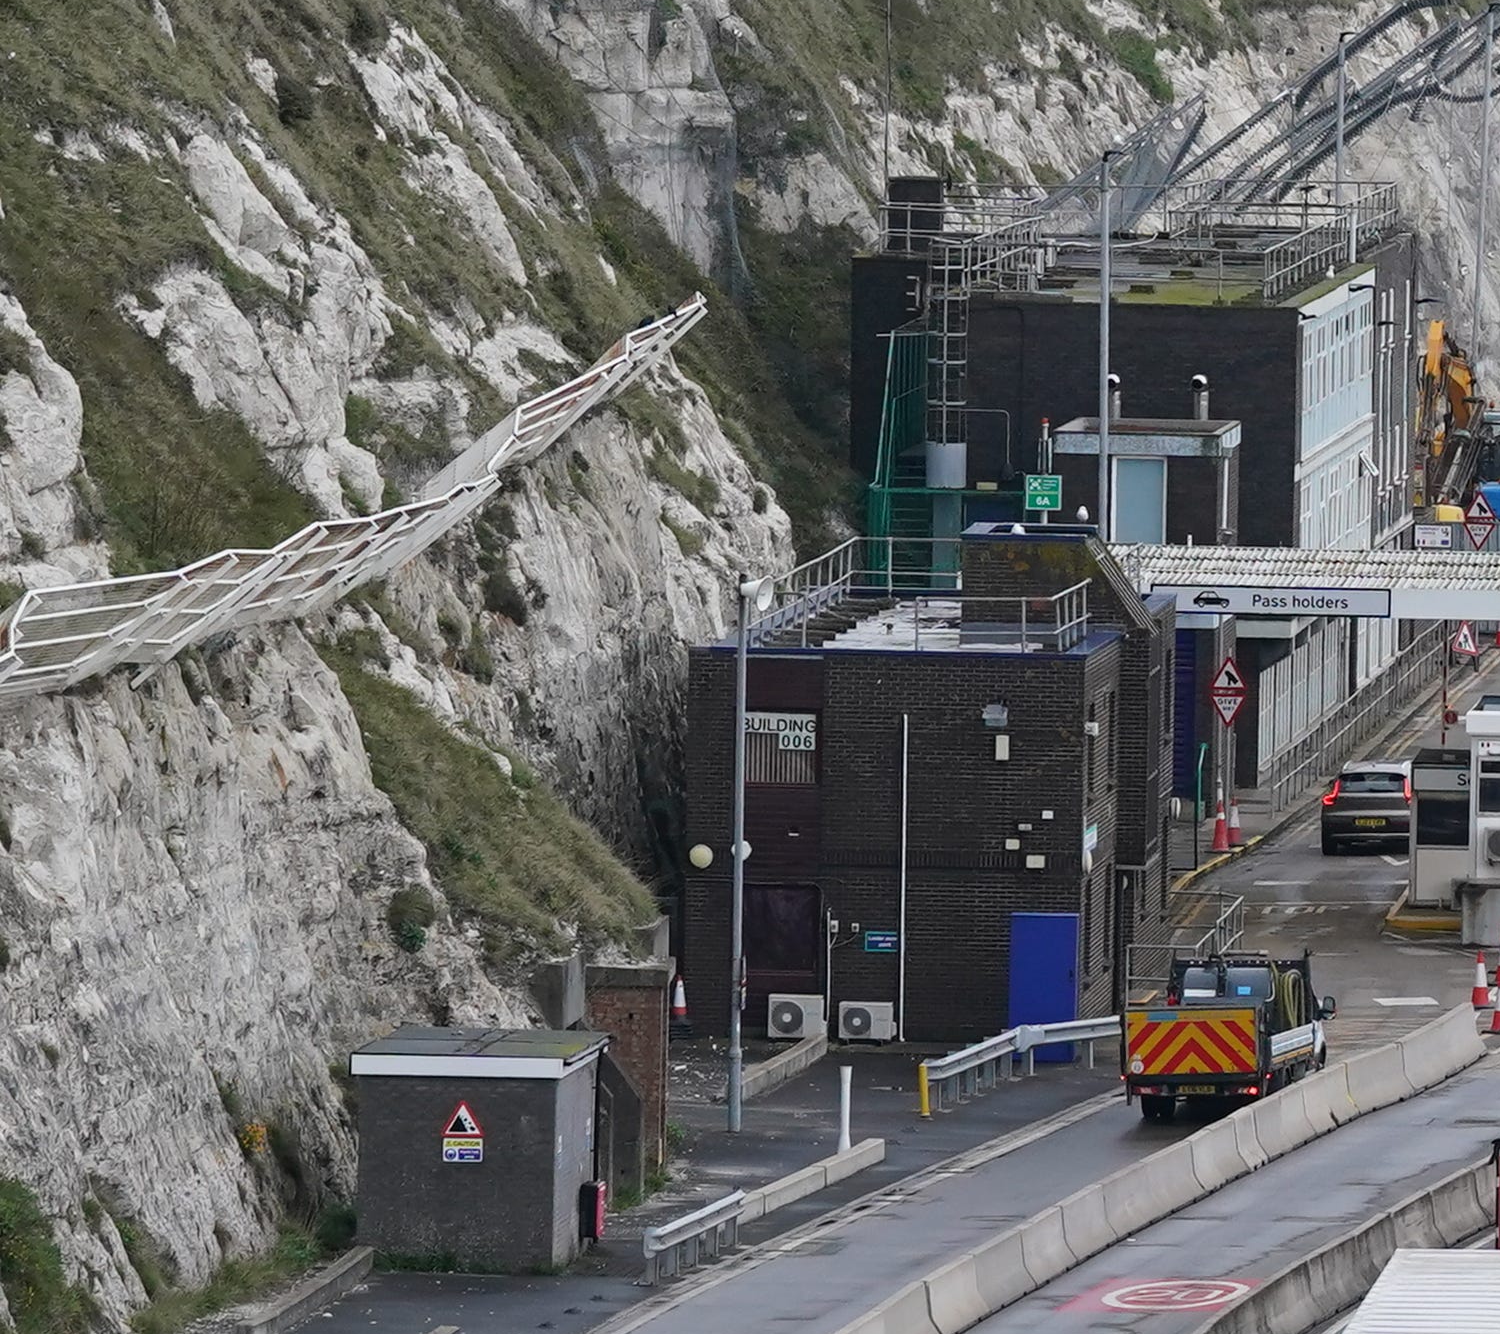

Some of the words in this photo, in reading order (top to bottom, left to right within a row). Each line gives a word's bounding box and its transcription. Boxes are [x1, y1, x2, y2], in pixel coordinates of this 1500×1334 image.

[1036, 496, 1050, 505] 6A
[1470, 525, 1488, 533] GIVE
[1252, 593, 1287, 608] Pass
[1292, 594, 1348, 609] holders
[1217, 697, 1238, 706] GIVE
[744, 718, 817, 732] BUILDING
[781, 734, 812, 748] 006
[1123, 1288, 1226, 1303] 20
